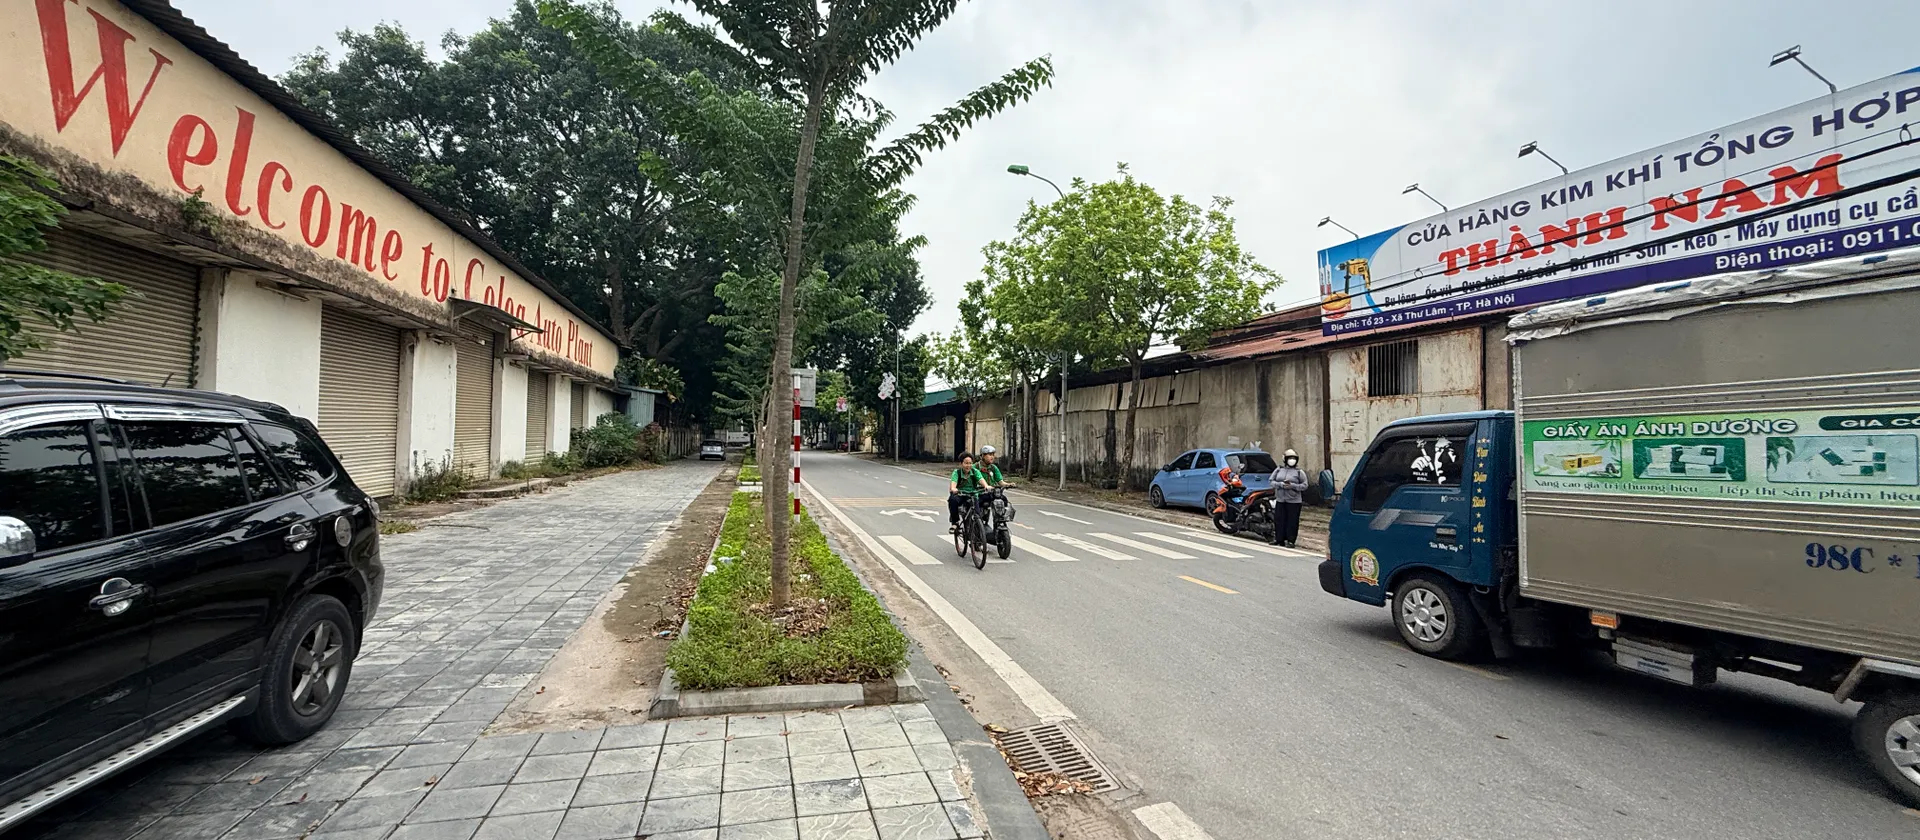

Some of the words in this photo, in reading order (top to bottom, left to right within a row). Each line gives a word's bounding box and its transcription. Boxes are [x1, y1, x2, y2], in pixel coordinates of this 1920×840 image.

[35, 0, 403, 281] Welcome
[420, 242, 449, 303] to
[530, 300, 562, 354] Auto
[566, 318, 593, 367] Plant
[1407, 223, 1452, 247] CỬA
[1459, 200, 1531, 233] HÀNG
[1540, 180, 1593, 210] KIM
[1606, 155, 1663, 192] KHÍ
[1674, 126, 1794, 173] TỔNG
[1812, 86, 1920, 137] HỢP
[1438, 206, 1628, 277] THÀNH
[1649, 153, 1845, 230] NAM
[1684, 233, 1718, 251] Keo
[1737, 220, 1779, 242] Máy
[1786, 208, 1840, 233] dụng
[1849, 200, 1878, 221] cụ
[1716, 252, 1762, 269] Điện
[1768, 238, 1834, 261] thoại:
[1331, 324, 1344, 332] Địa
[1373, 316, 1384, 325] 23
[1405, 310, 1424, 319] Thư
[1425, 305, 1447, 317] Lâm
[1456, 301, 1473, 312] TP.
[1476, 297, 1493, 308] Hà
[1494, 293, 1515, 305] Nội
[1543, 421, 1591, 437] GIẤY
[1597, 421, 1628, 437] ĂN
[1634, 419, 1686, 436] ÁNH
[1692, 418, 1798, 435] DƯƠNG
[1840, 419, 1884, 428] GIA
[1805, 542, 1875, 574] 98C
